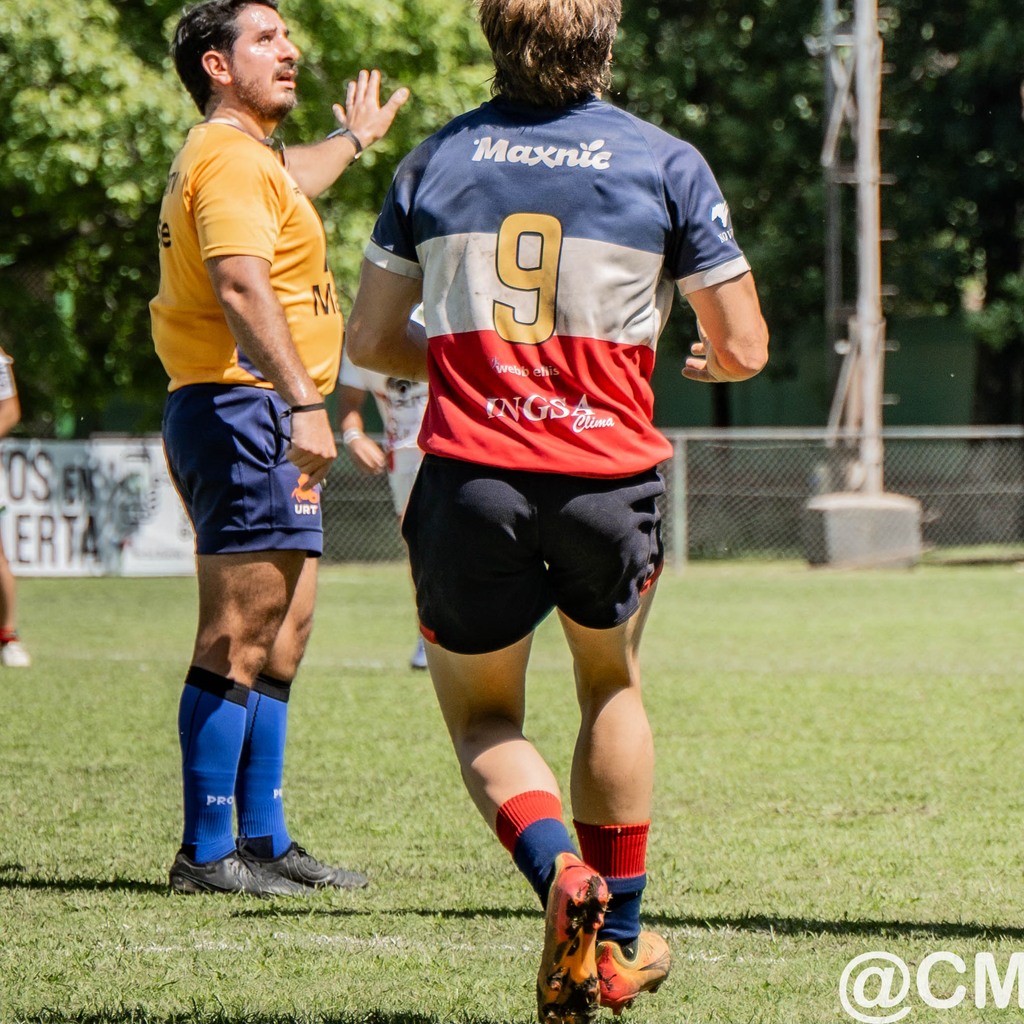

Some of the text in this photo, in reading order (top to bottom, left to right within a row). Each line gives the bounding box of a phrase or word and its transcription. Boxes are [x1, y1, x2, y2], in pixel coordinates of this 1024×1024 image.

[471, 136, 613, 171] Maxnic
[493, 212, 562, 346] 9
[495, 364, 560, 377] webb ellis
[486, 393, 596, 422] INGSA
[572, 414, 615, 433] Clima
[8, 450, 52, 502] OS
[294, 503, 319, 516] URT
